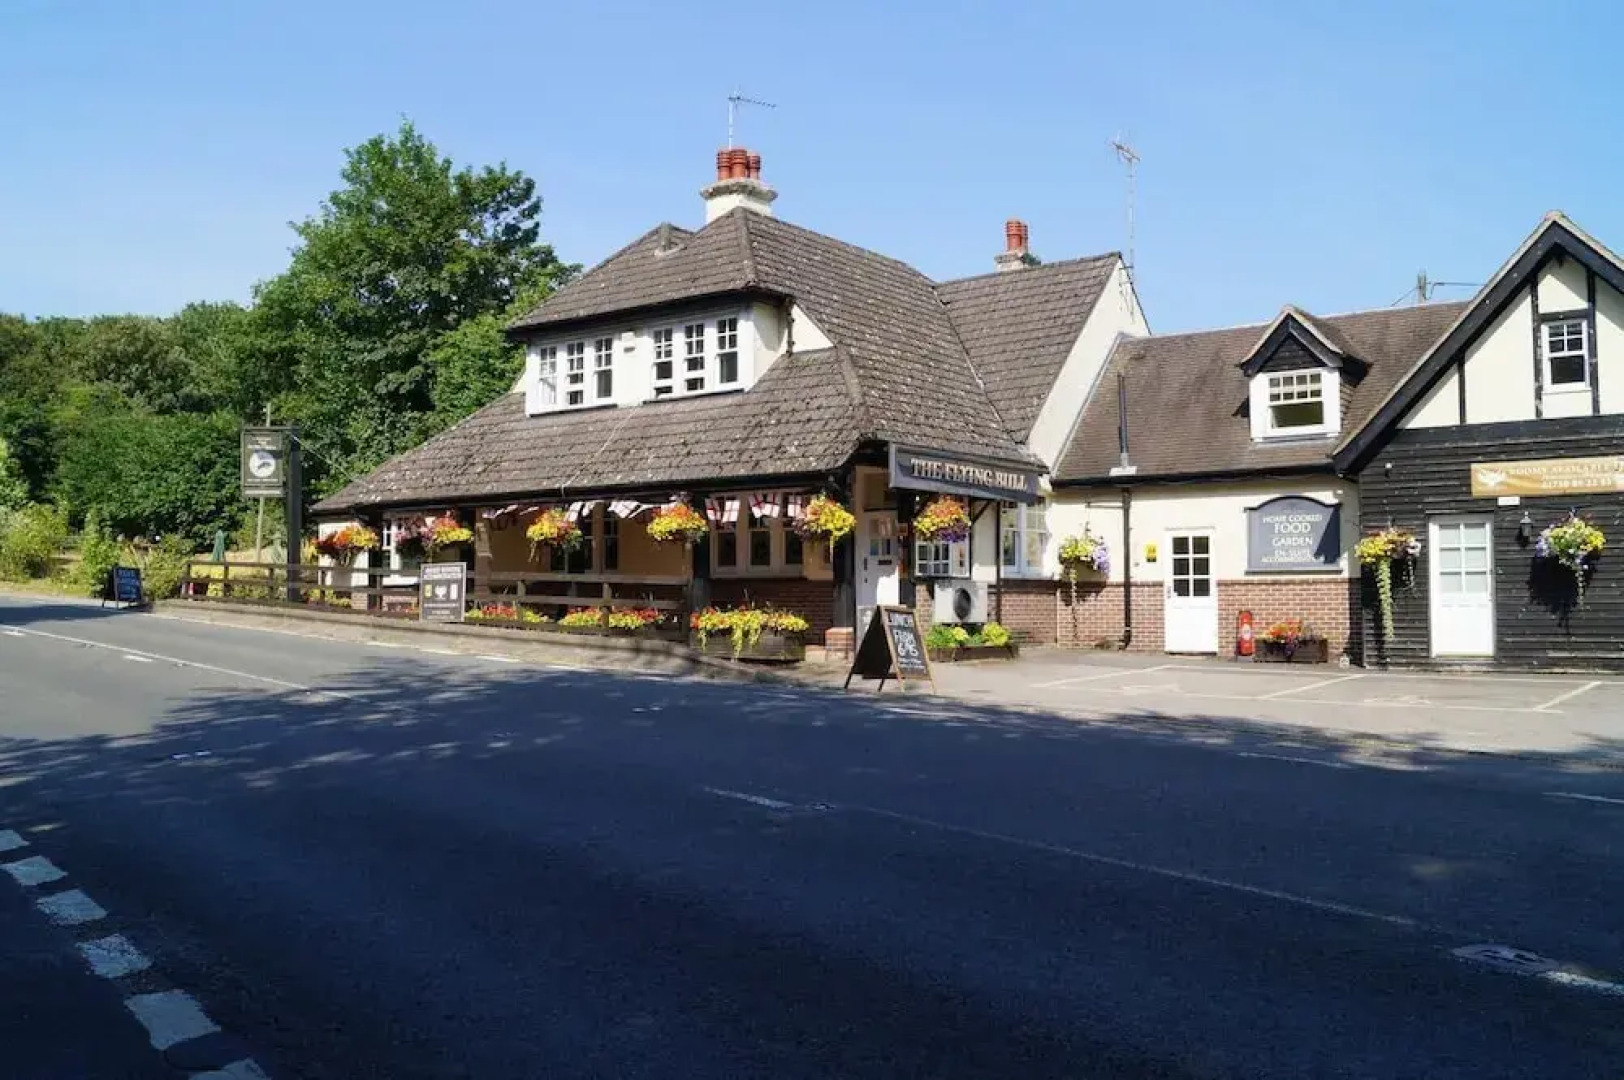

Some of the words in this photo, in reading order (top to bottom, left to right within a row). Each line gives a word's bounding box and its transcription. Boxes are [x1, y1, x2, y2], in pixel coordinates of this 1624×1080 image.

[911, 458, 942, 478] THE
[945, 463, 993, 487] FLYING
[1288, 514, 1323, 522] COOKED
[1274, 522, 1311, 533] FOOD
[1272, 536, 1313, 546] GARDEN
